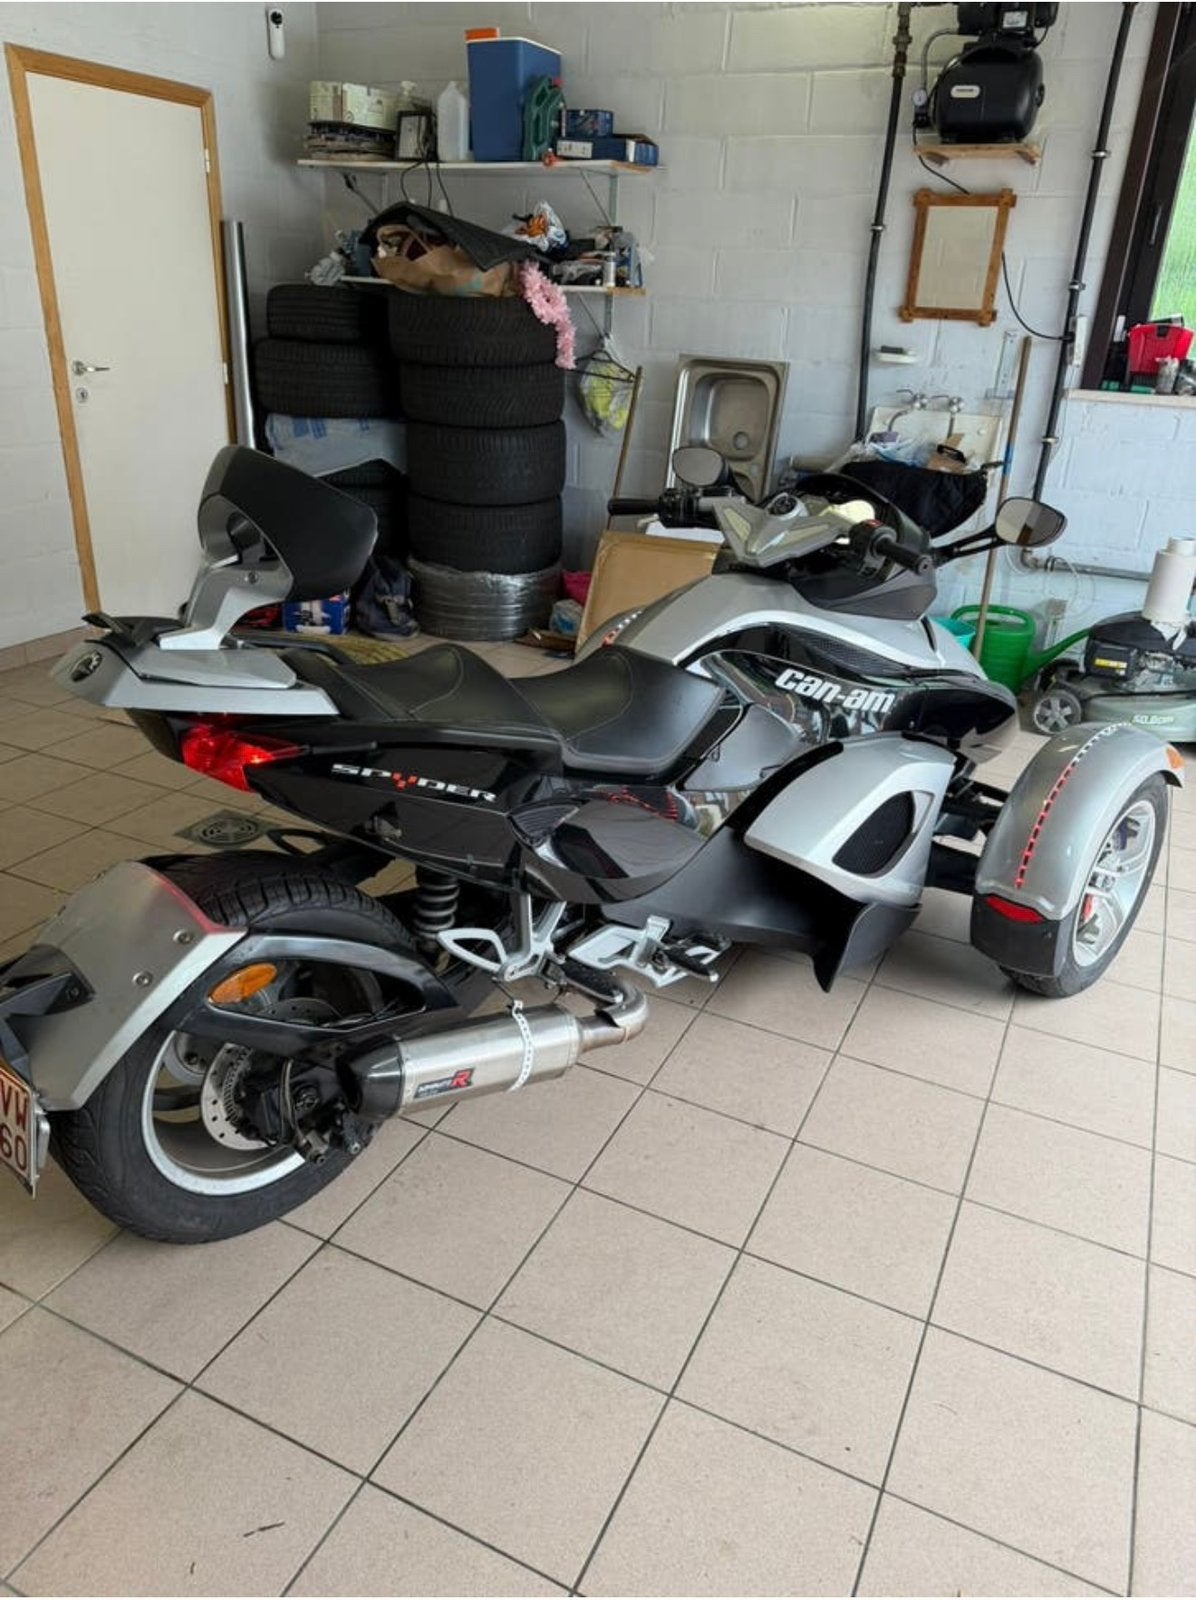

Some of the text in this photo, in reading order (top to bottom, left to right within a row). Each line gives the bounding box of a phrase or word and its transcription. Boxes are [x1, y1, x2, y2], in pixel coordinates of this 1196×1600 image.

[775, 668, 896, 713] can-am
[331, 764, 497, 801] SPYDER
[0, 1123, 27, 1171] 60
